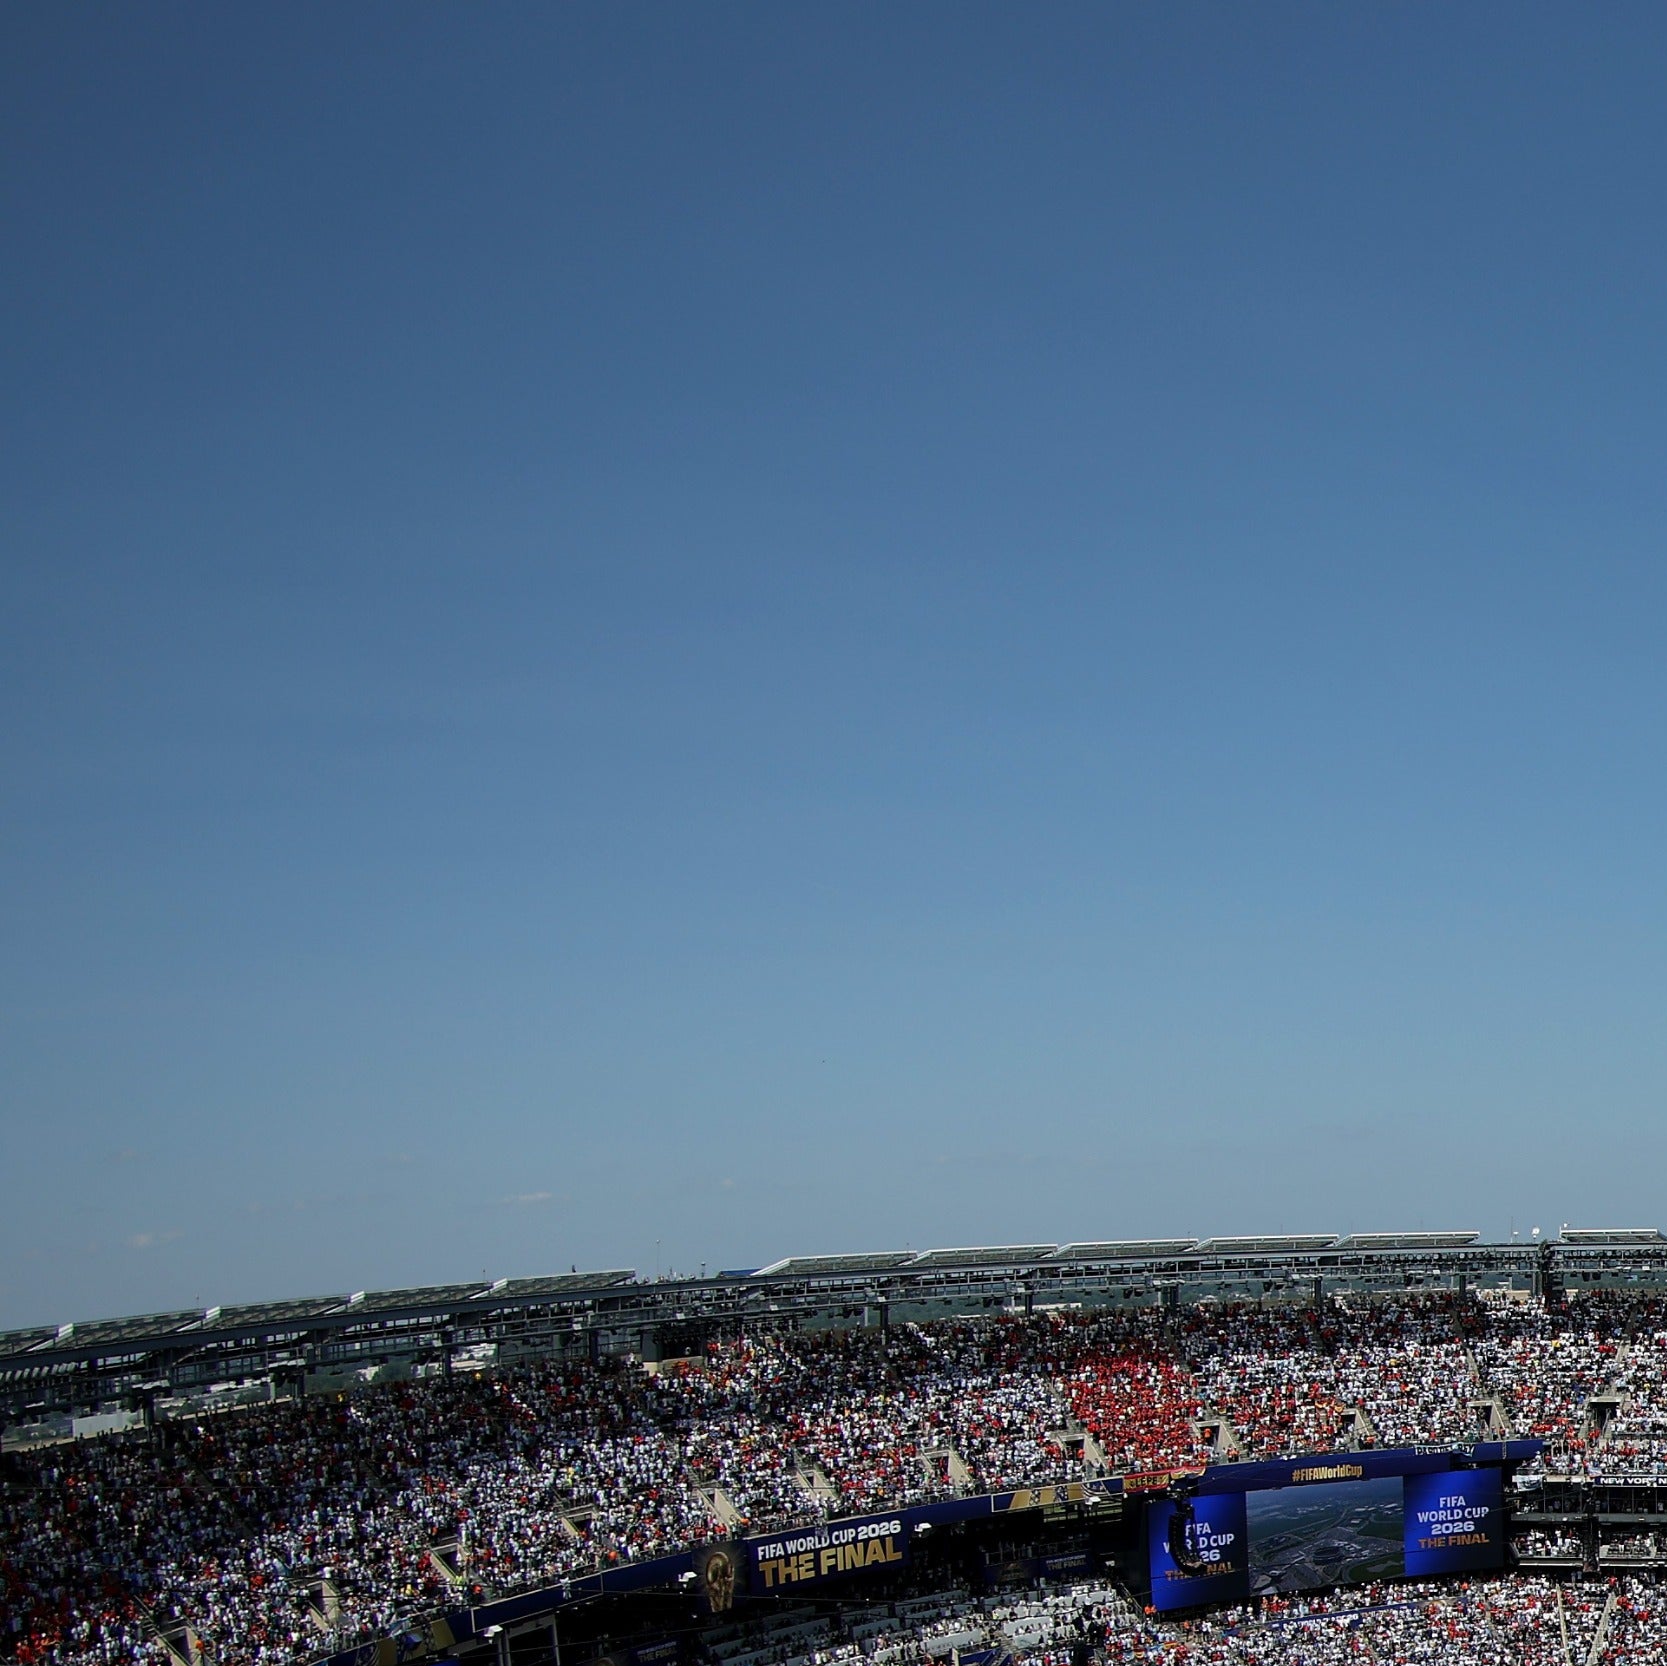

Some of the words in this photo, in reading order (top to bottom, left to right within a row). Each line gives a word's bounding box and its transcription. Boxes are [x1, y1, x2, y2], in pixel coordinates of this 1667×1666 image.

[1291, 1464, 1365, 1483] #FIFAWorldCup
[1600, 1477, 1625, 1485] NEW
[1438, 1495, 1467, 1508] FIFA
[1416, 1508, 1463, 1524] WORLD
[1464, 1506, 1490, 1519] CUP
[1430, 1521, 1476, 1535] 2026
[757, 1543, 785, 1561] FIFA
[787, 1535, 830, 1555] WORLD
[831, 1528, 856, 1544] CUP
[857, 1519, 902, 1540] 2026
[1210, 1533, 1235, 1547] CUP
[1418, 1537, 1446, 1549] THE
[1447, 1533, 1491, 1547] FINAL
[758, 1556, 817, 1588] THE
[820, 1537, 904, 1576] FINAL
